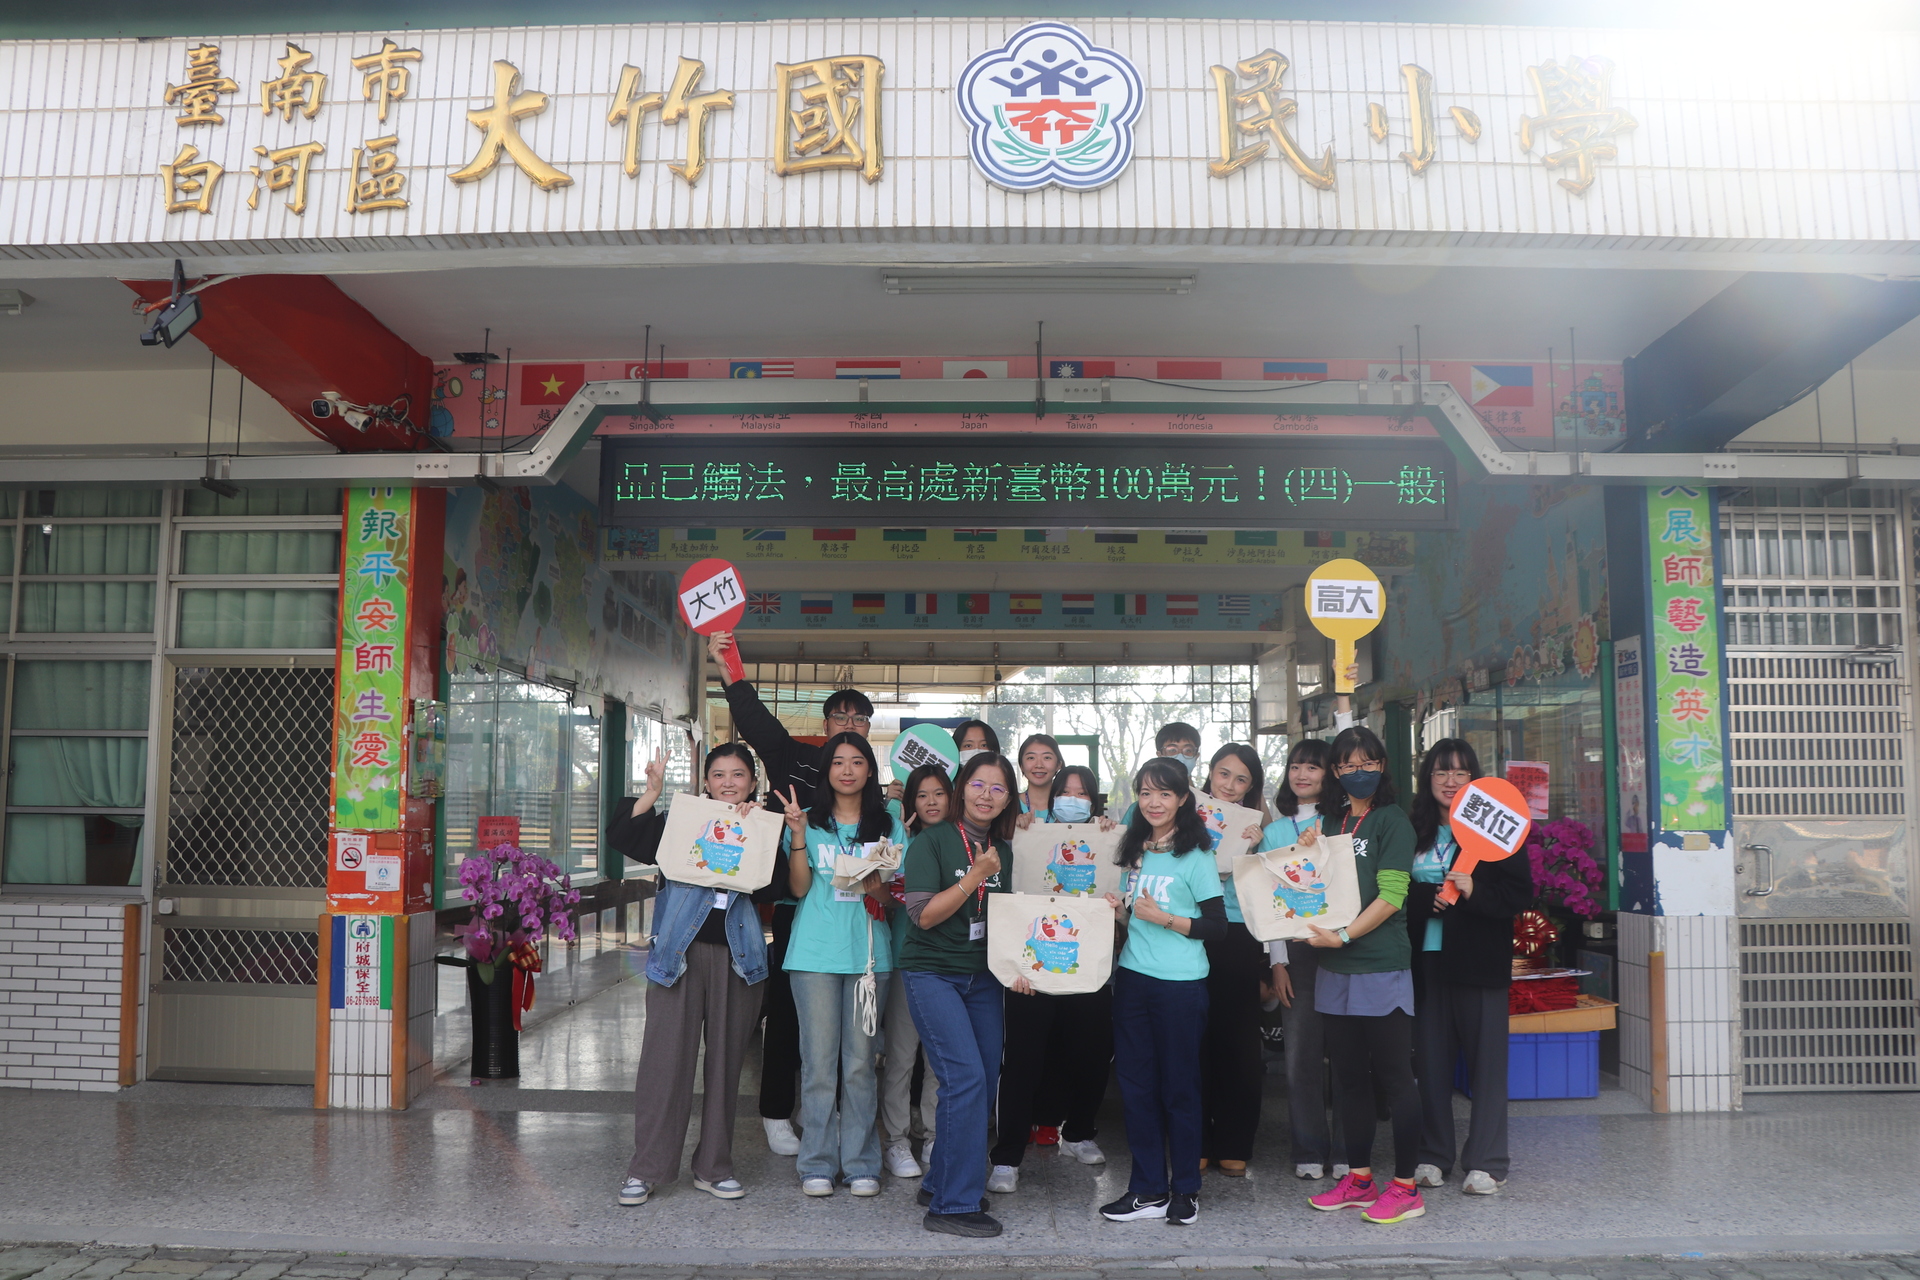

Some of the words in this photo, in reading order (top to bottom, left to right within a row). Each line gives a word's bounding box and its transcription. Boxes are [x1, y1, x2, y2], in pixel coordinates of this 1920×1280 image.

[168, 37, 422, 126] 臺南市
[161, 135, 411, 216] 白河區
[629, 422, 675, 431] Singapore
[741, 420, 781, 431] Malaysia
[848, 420, 889, 430] Thailand
[960, 420, 989, 431] Japan
[1066, 420, 1098, 430] Taiwan
[1168, 421, 1214, 431] Indonesia
[1273, 421, 1320, 431] Cambodia
[1387, 423, 1414, 432] Korea
[670, 542, 719, 553] 馬達加斯加
[755, 543, 776, 552] 南非
[820, 543, 850, 553] 摩洛哥
[890, 543, 920, 553] 利比亞
[966, 543, 985, 553] 肯亞
[1020, 544, 1071, 555] 阿爾及利亞
[1106, 545, 1127, 556] 埃及
[1172, 546, 1203, 557] 伊拉克
[746, 551, 762, 559] South
[764, 551, 784, 559] Africa
[897, 552, 914, 560] Libya
[966, 553, 985, 561] Kenya
[1226, 547, 1286, 559] 沙烏地阿拉伯
[1107, 555, 1126, 563] Egypt
[1182, 556, 1195, 564] Iraq
[689, 576, 733, 620] 大竹
[1317, 585, 1373, 614] 高大
[861, 615, 876, 624] 德國
[914, 616, 929, 624] 法國
[353, 487, 401, 767] 報平安師生愛
[1461, 793, 1520, 846] 數位
[356, 941, 371, 993] 府城保全
